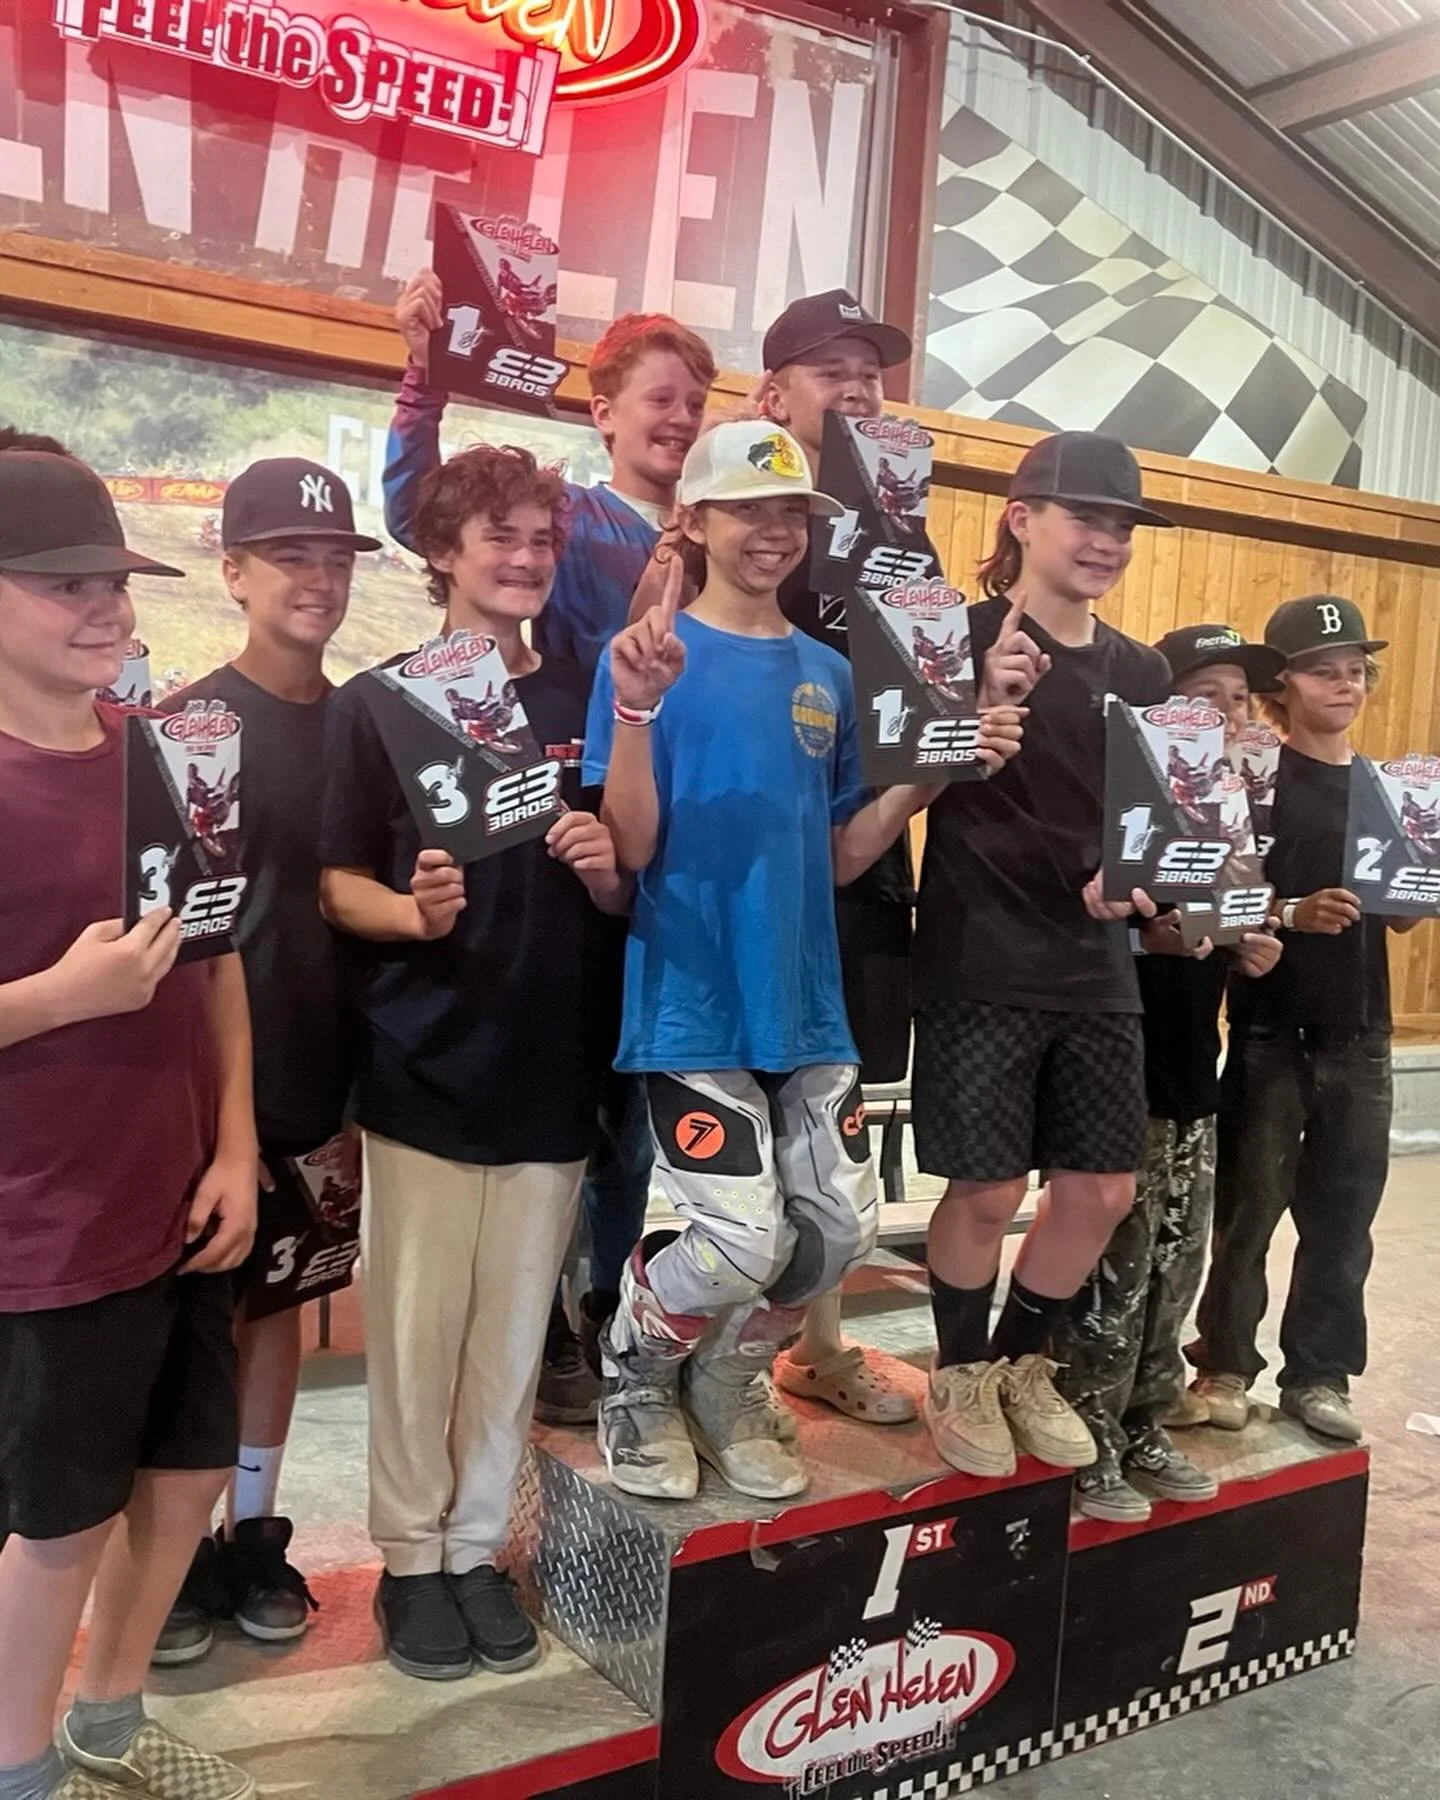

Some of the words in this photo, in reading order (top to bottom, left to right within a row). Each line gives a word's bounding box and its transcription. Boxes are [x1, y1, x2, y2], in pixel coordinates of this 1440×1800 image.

[228, 9, 314, 81] the
[326, 28, 518, 130] SPEED!
[484, 372, 550, 397] 3BROS
[859, 570, 911, 588] 3BRO
[1316, 603, 1343, 635] B
[916, 749, 977, 764] 3BROS
[487, 795, 554, 833] 3BROS
[1154, 870, 1216, 884] 3BROS
[764, 1665, 873, 1760] GLEN
[879, 1638, 977, 1723] HELEN
[802, 1757, 846, 1794] FEEL
[876, 1720, 942, 1767] SPEED!
